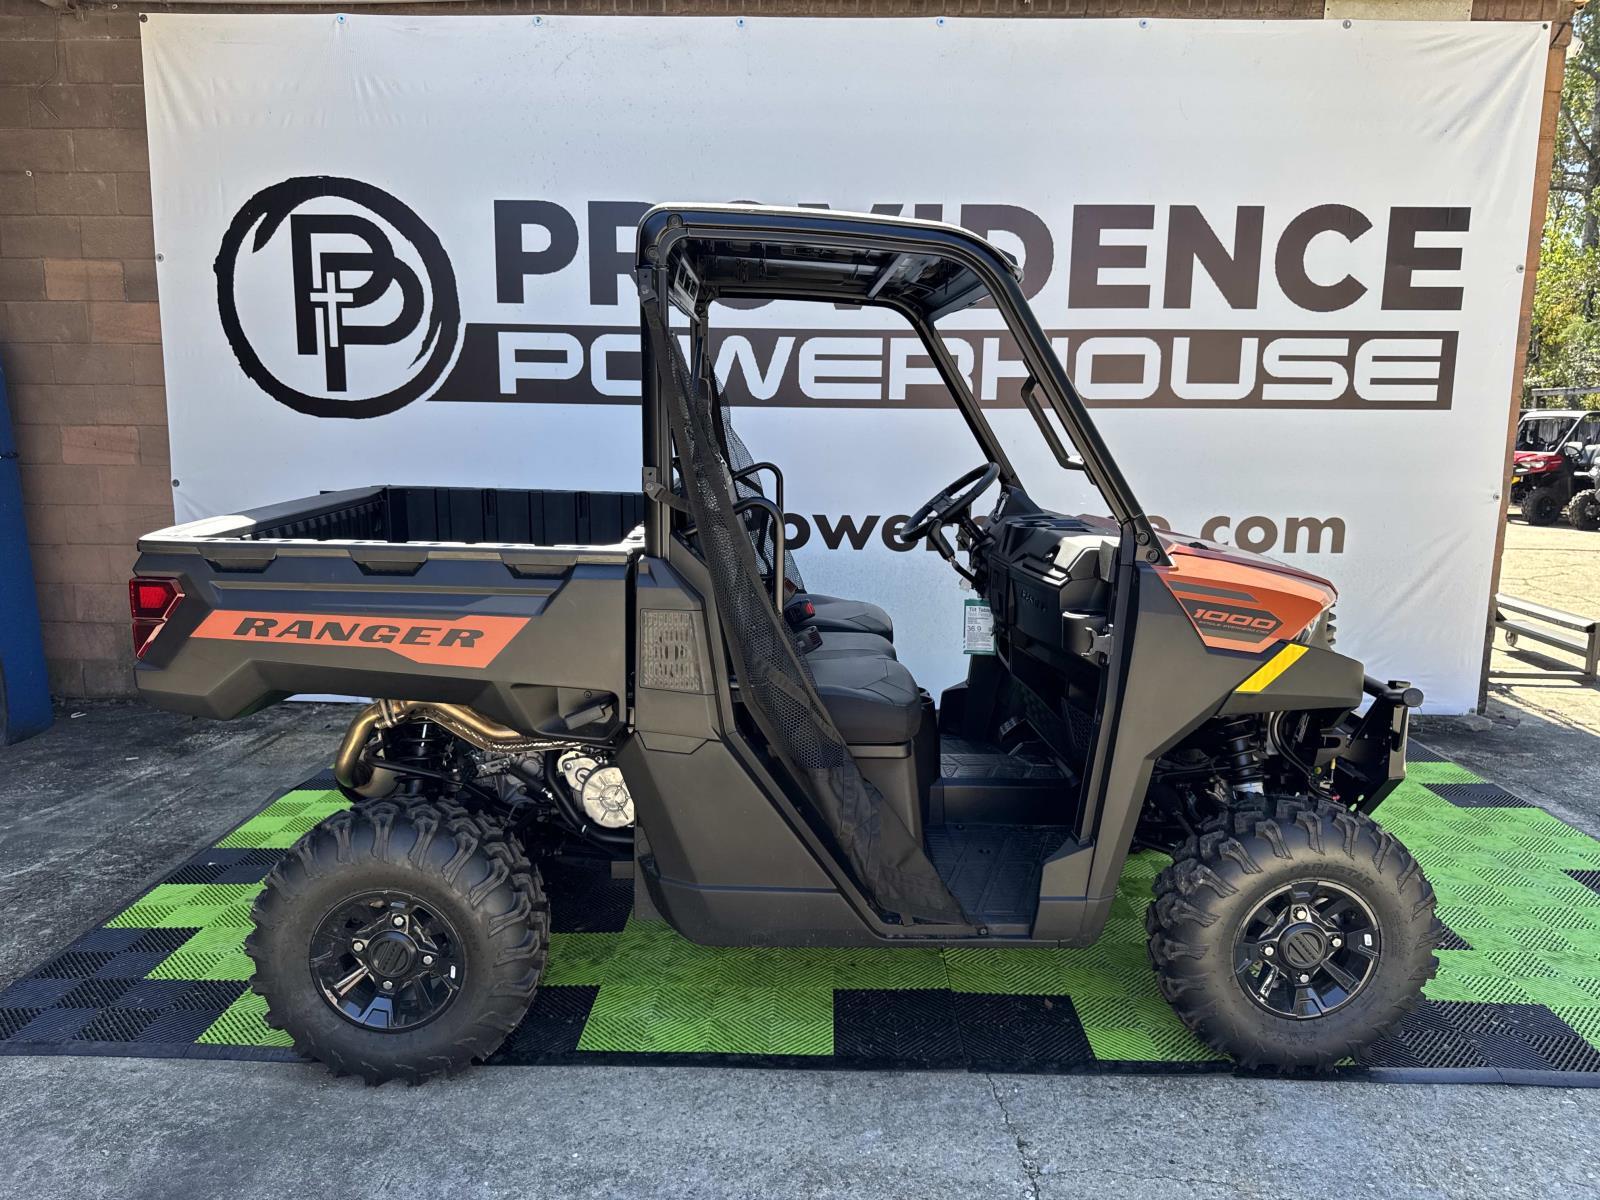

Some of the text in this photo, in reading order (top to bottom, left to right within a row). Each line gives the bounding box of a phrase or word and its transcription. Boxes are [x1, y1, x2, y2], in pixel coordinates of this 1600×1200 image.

[493, 199, 1472, 313] PRDENCE
[233, 617, 484, 648] RANGER
[1193, 608, 1277, 630] 1000
